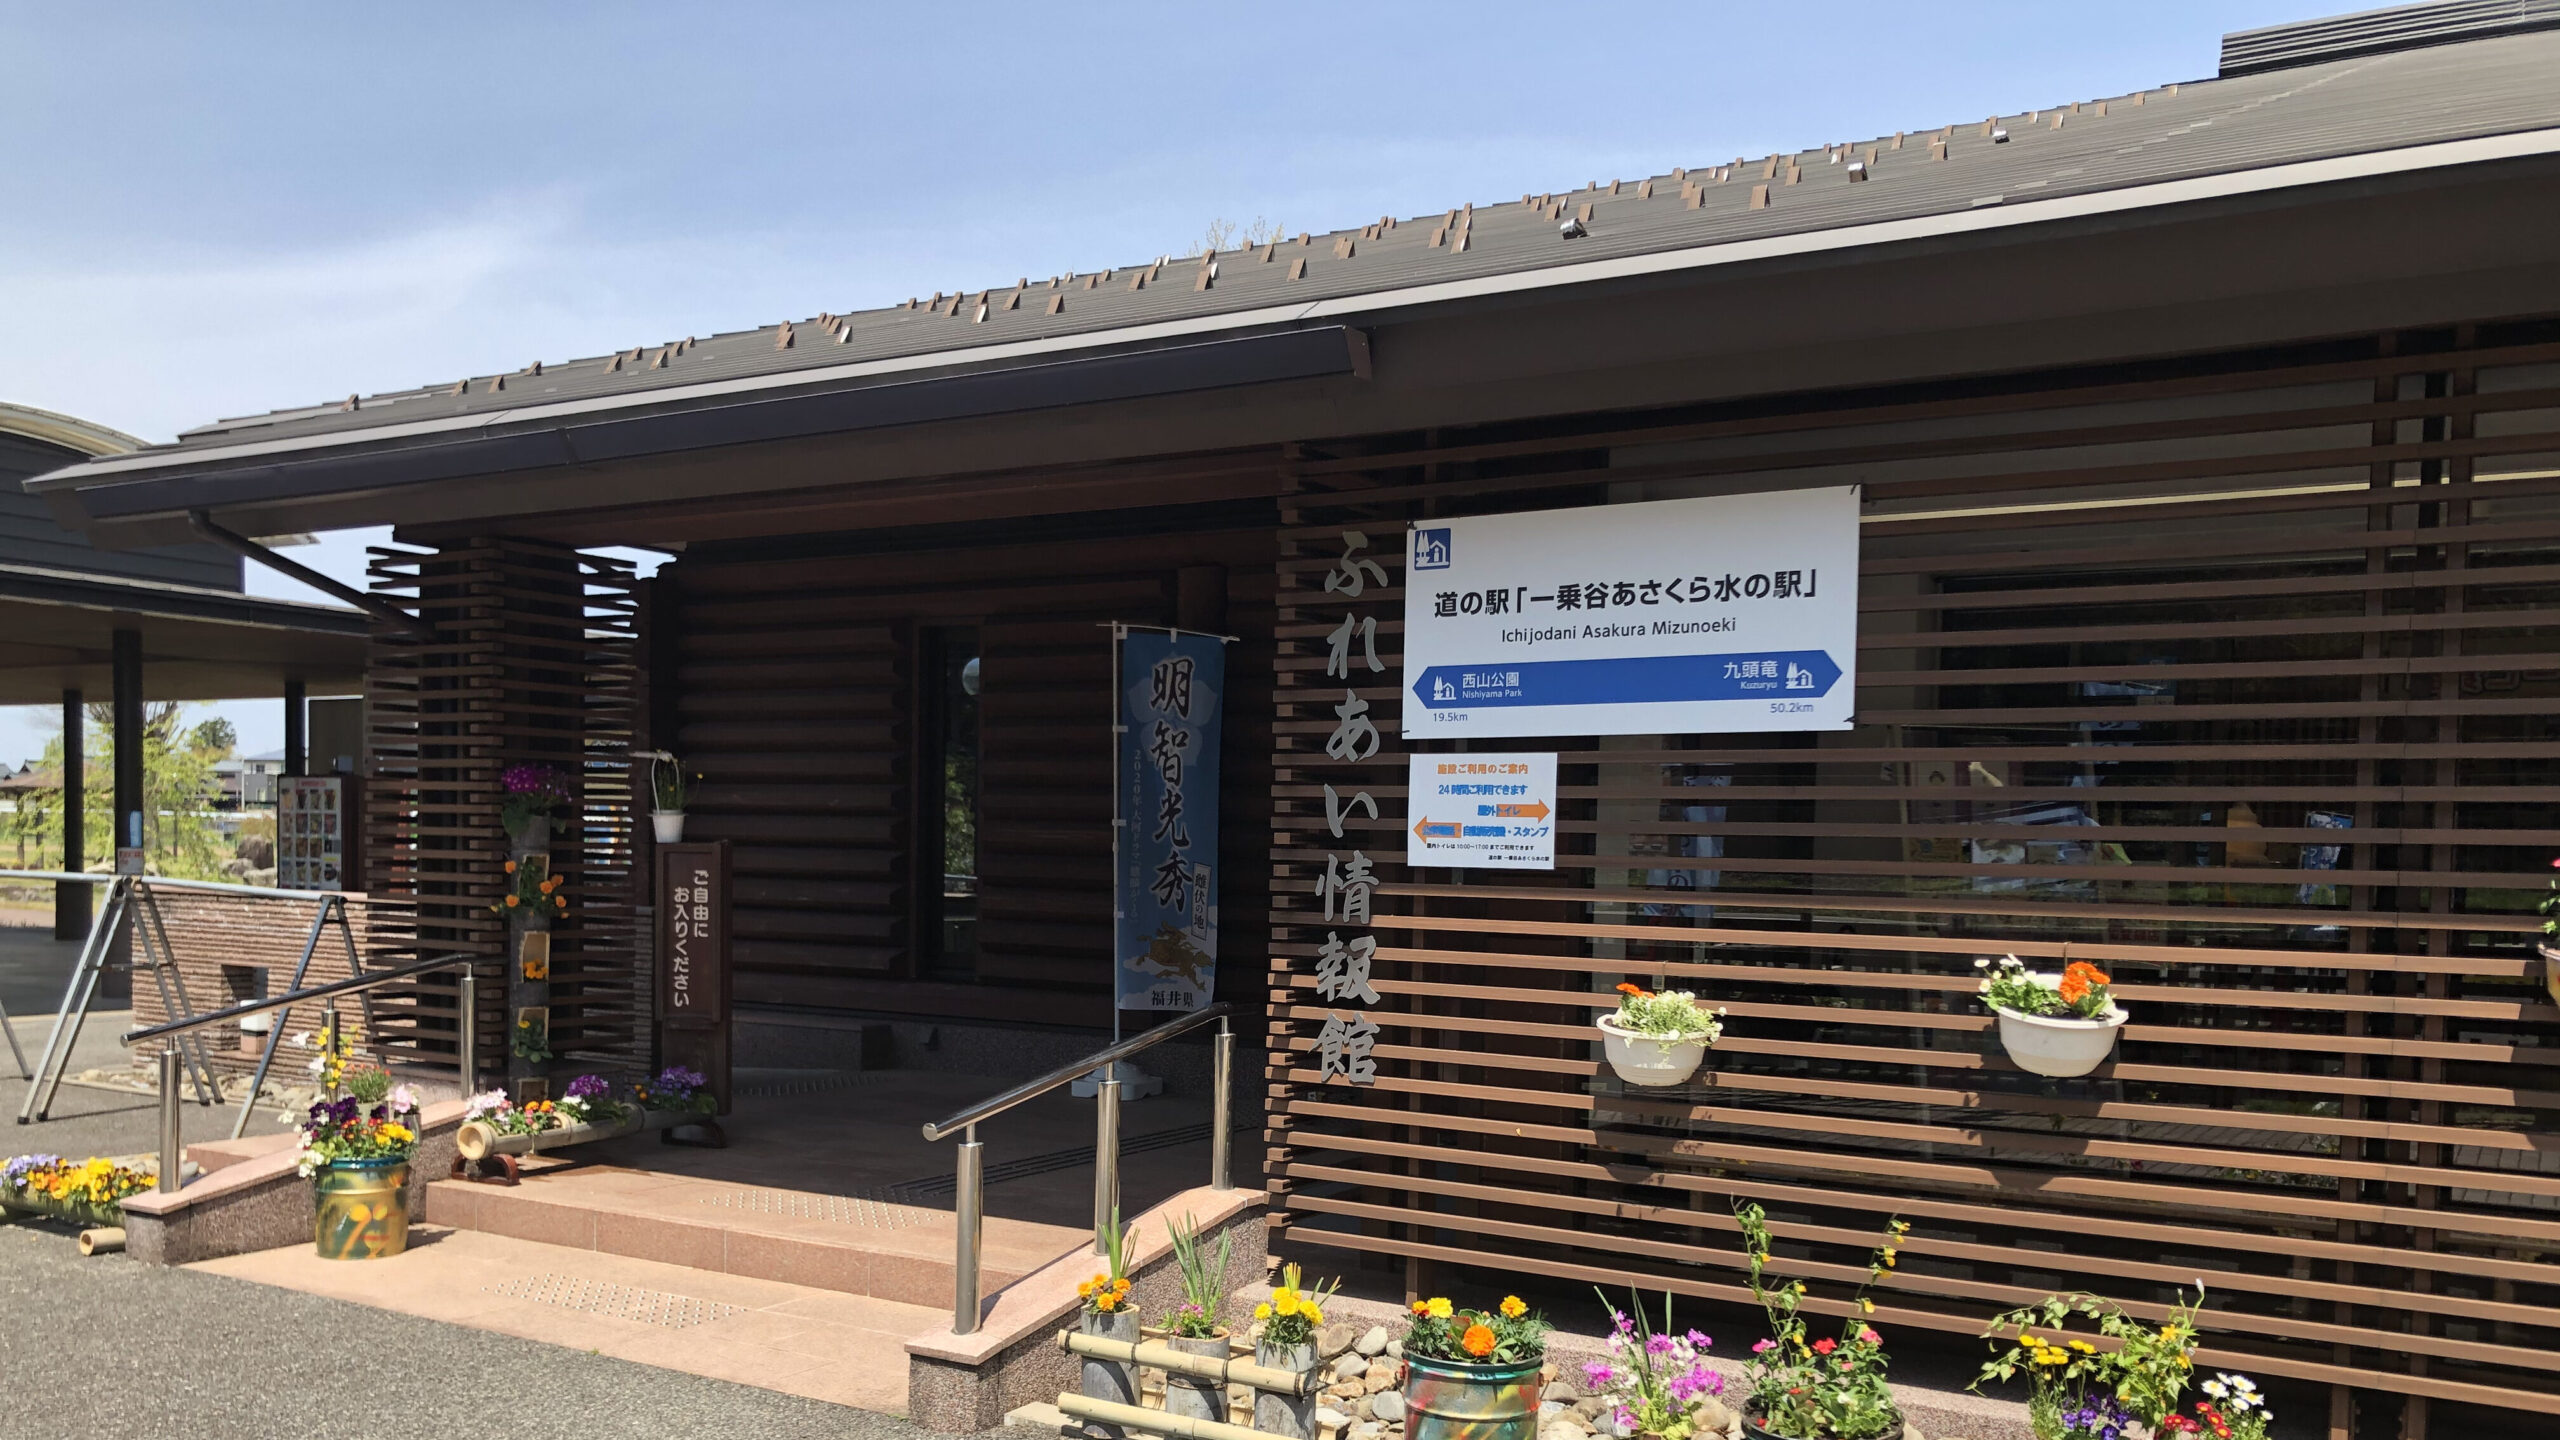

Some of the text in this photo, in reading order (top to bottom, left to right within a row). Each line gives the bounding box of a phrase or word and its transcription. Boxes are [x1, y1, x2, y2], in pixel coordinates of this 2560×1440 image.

[1434, 568, 1816, 618] 道の駅「一乗谷あさくら水の駅」
[1502, 617, 1736, 646] Ichijodani Asakura Mizunoeki
[1723, 660, 1779, 680] 九頭竜
[1462, 672, 1520, 689] 西山公園
[1740, 680, 1778, 691] Kuzuryu
[1462, 688, 1523, 701] Nishiyama Park
[1433, 712, 1468, 722] 19.5km
[1770, 702, 1814, 714] 50.2km
[1148, 657, 1194, 914] 明智光秀
[1307, 530, 1388, 1085] ふれあい情報館
[693, 869, 710, 938] ご自由に
[673, 886, 690, 1007] お入りください
[1150, 989, 1195, 1008] 福井県
